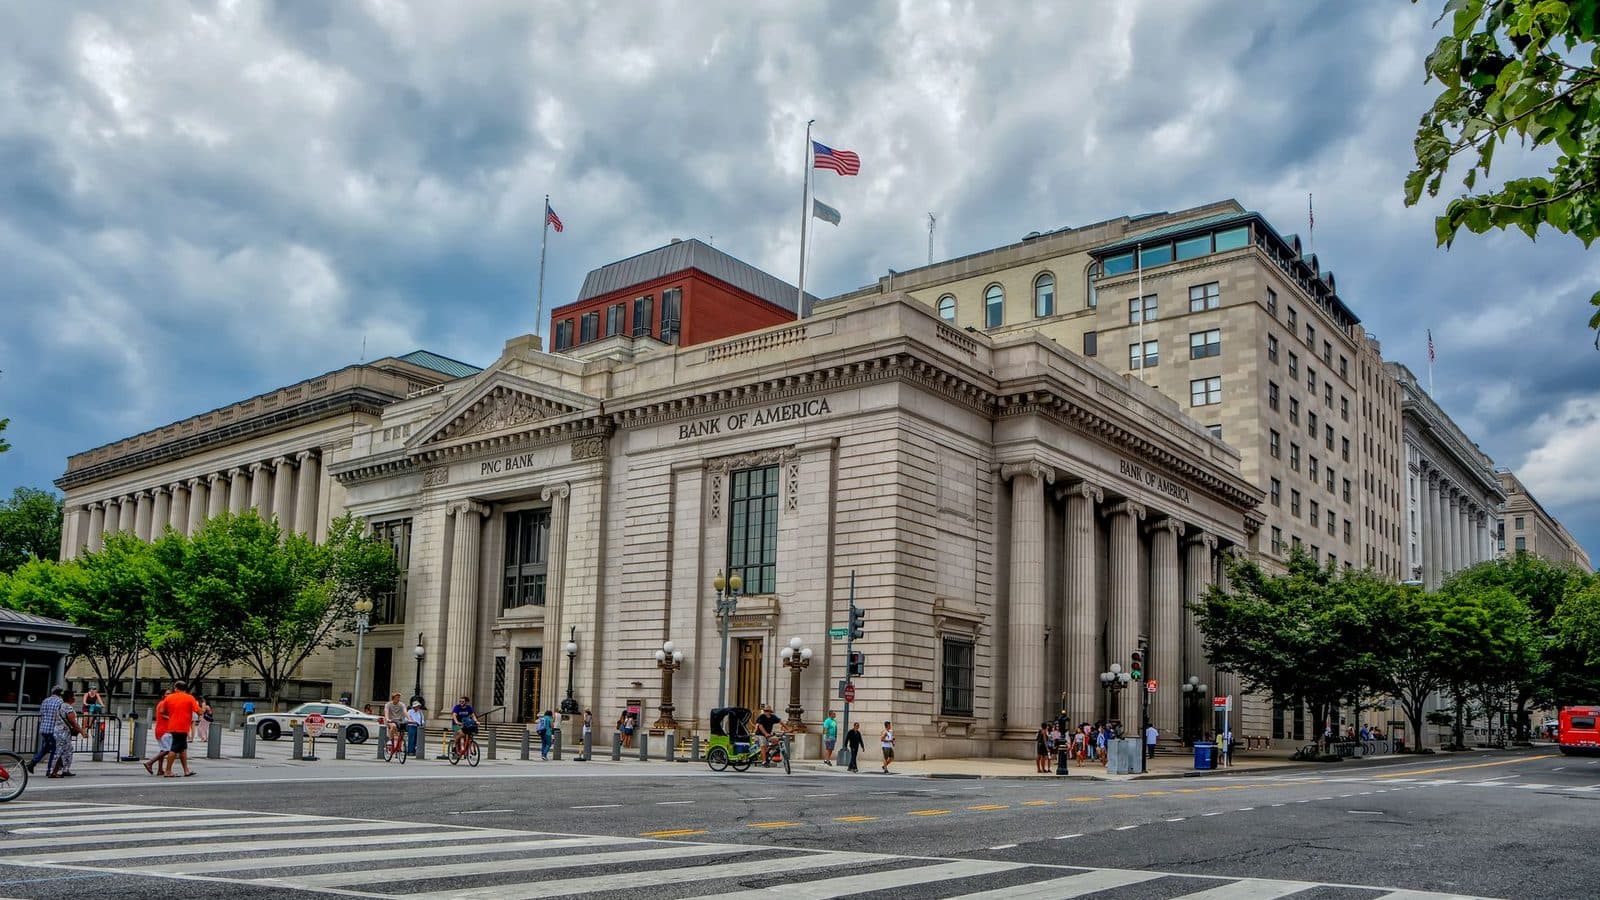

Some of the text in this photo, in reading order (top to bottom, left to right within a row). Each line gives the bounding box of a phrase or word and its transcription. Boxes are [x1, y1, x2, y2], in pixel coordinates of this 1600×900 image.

[679, 397, 832, 440] BANK OF AMERICA
[481, 453, 534, 475] PNC BANK
[1120, 459, 1190, 504] BANK OF AMERICA
